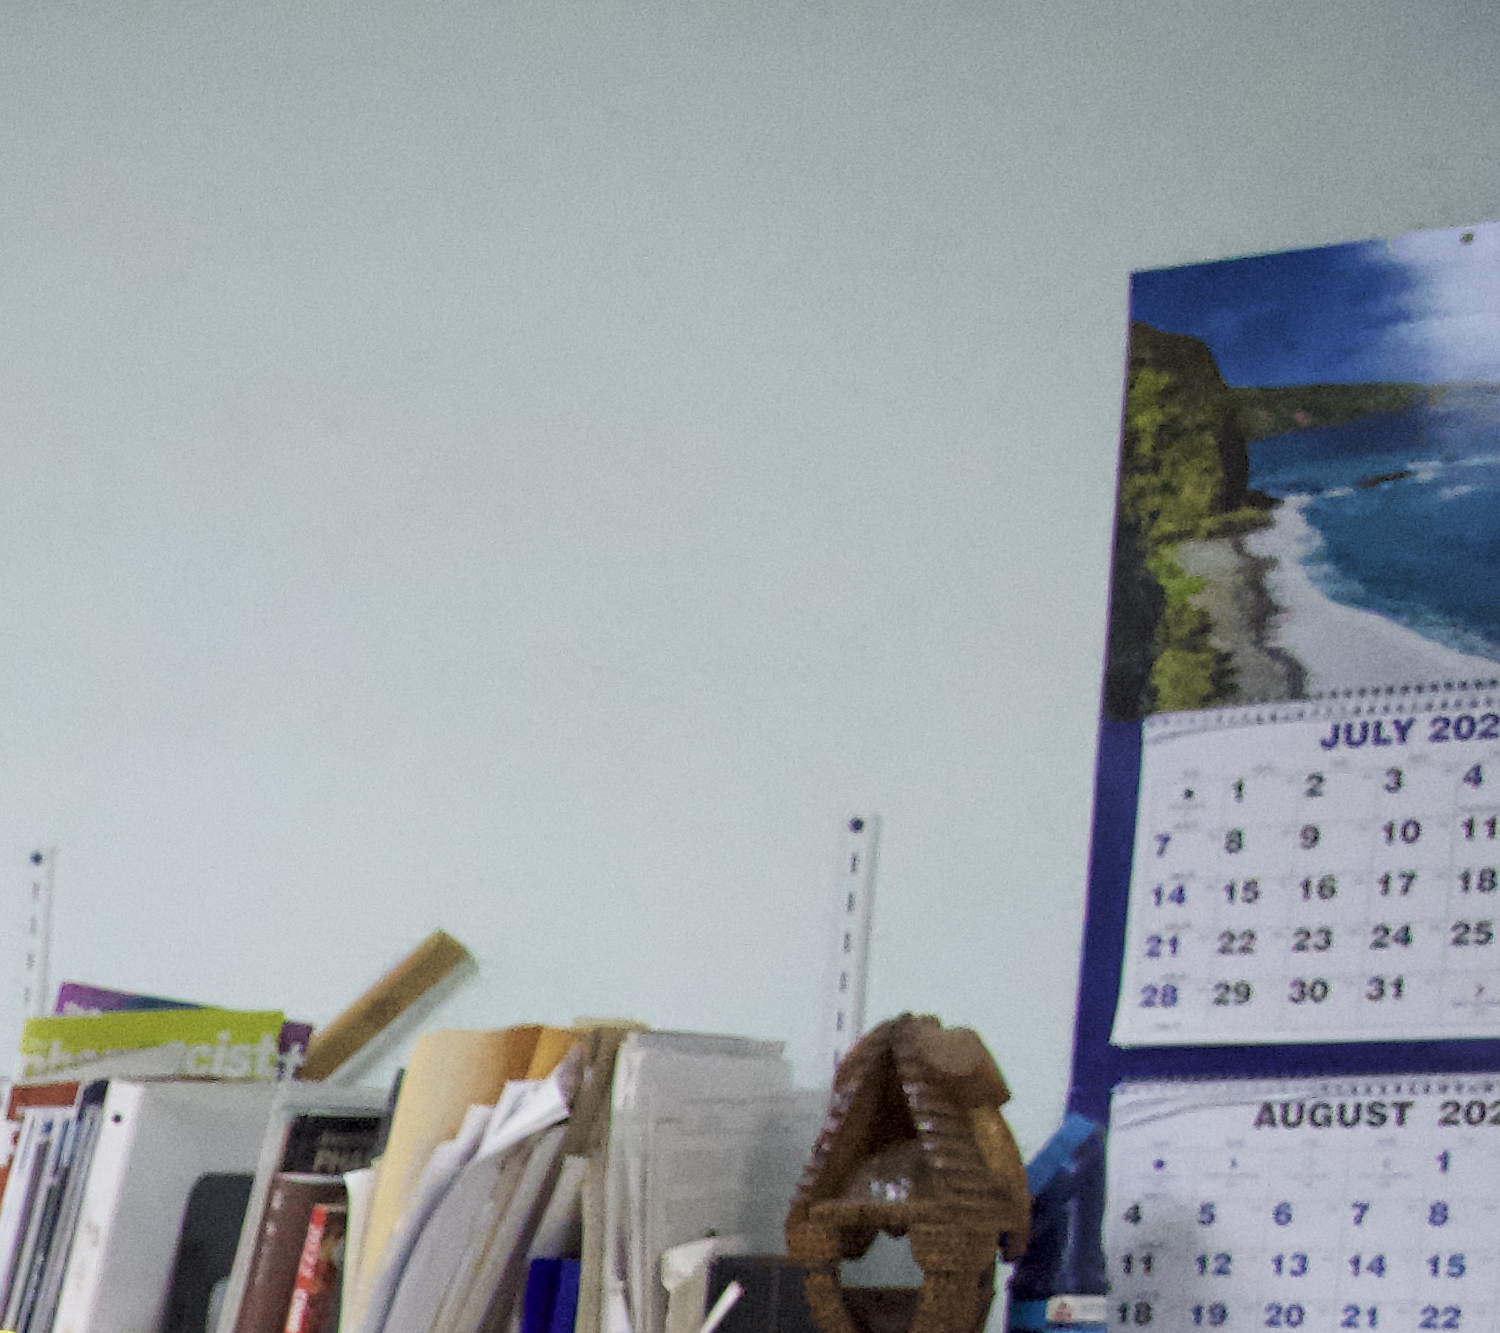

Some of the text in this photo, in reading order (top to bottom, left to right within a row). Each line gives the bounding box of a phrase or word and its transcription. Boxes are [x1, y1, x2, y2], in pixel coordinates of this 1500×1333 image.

[1320, 713, 1500, 750] JULY 202
[1232, 763, 1483, 802] 1 2 3 4
[1156, 816, 1499, 858] 7 8 9 10 11
[1152, 867, 1498, 907] 14 15 16 17 18
[1146, 920, 1494, 958] 21 22 23 24 25
[1140, 974, 1404, 1008] 28 29 30 31
[1253, 1100, 1415, 1129] AUGUST
[1436, 1149, 1451, 1173] 1
[1123, 1201, 1449, 1227] 4 5 6 7 8
[1122, 1252, 1466, 1279] 11 12 13 14 15
[1117, 1301, 1462, 1331] 18 19 20 21 22
